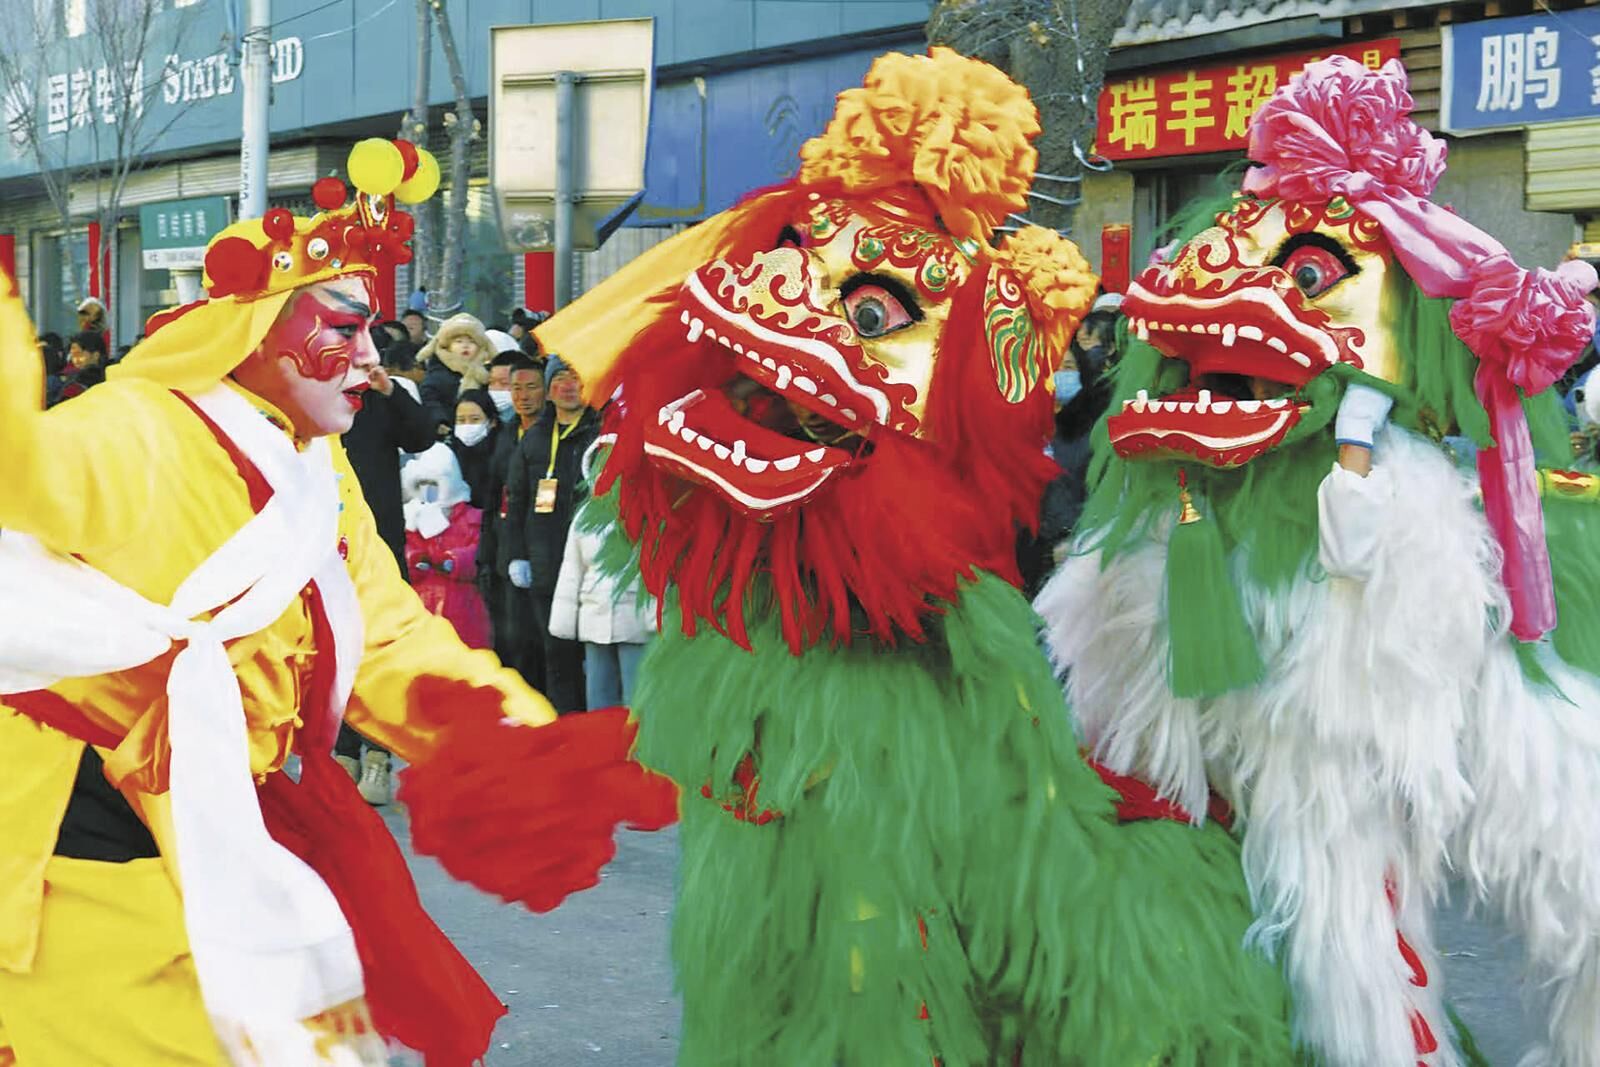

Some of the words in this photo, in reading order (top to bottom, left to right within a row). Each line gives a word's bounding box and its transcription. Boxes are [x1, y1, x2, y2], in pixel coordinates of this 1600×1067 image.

[1108, 57, 1320, 151] 瑞丰超
[1476, 26, 1600, 111] 鹏
